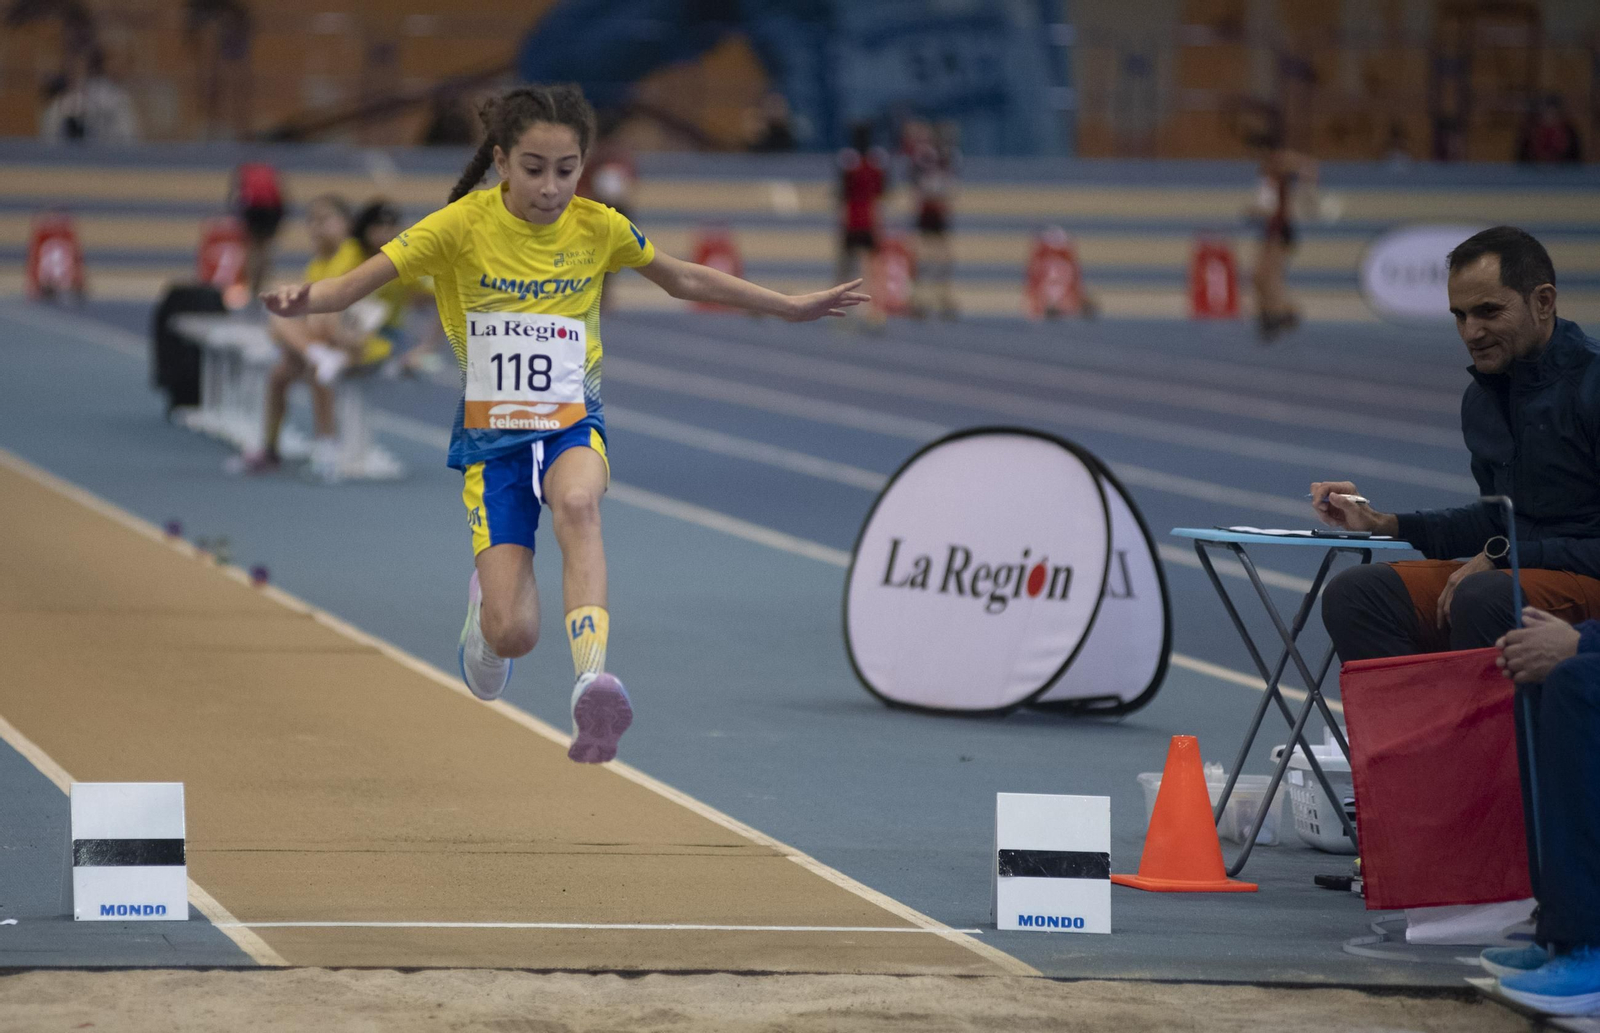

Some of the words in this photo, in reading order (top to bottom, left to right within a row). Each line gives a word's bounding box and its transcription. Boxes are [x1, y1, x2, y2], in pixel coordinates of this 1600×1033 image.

[565, 249, 596, 259] ARRANZ
[565, 258, 596, 267] DENTAL
[470, 320, 497, 337] La
[503, 320, 580, 342] Región
[490, 353, 552, 392] 118
[489, 416, 561, 429] telemiño
[880, 536, 934, 592] La
[938, 543, 1076, 616] Región
[571, 615, 596, 640] LA
[100, 904, 167, 917] MONDO
[1018, 914, 1085, 929] MONDO
